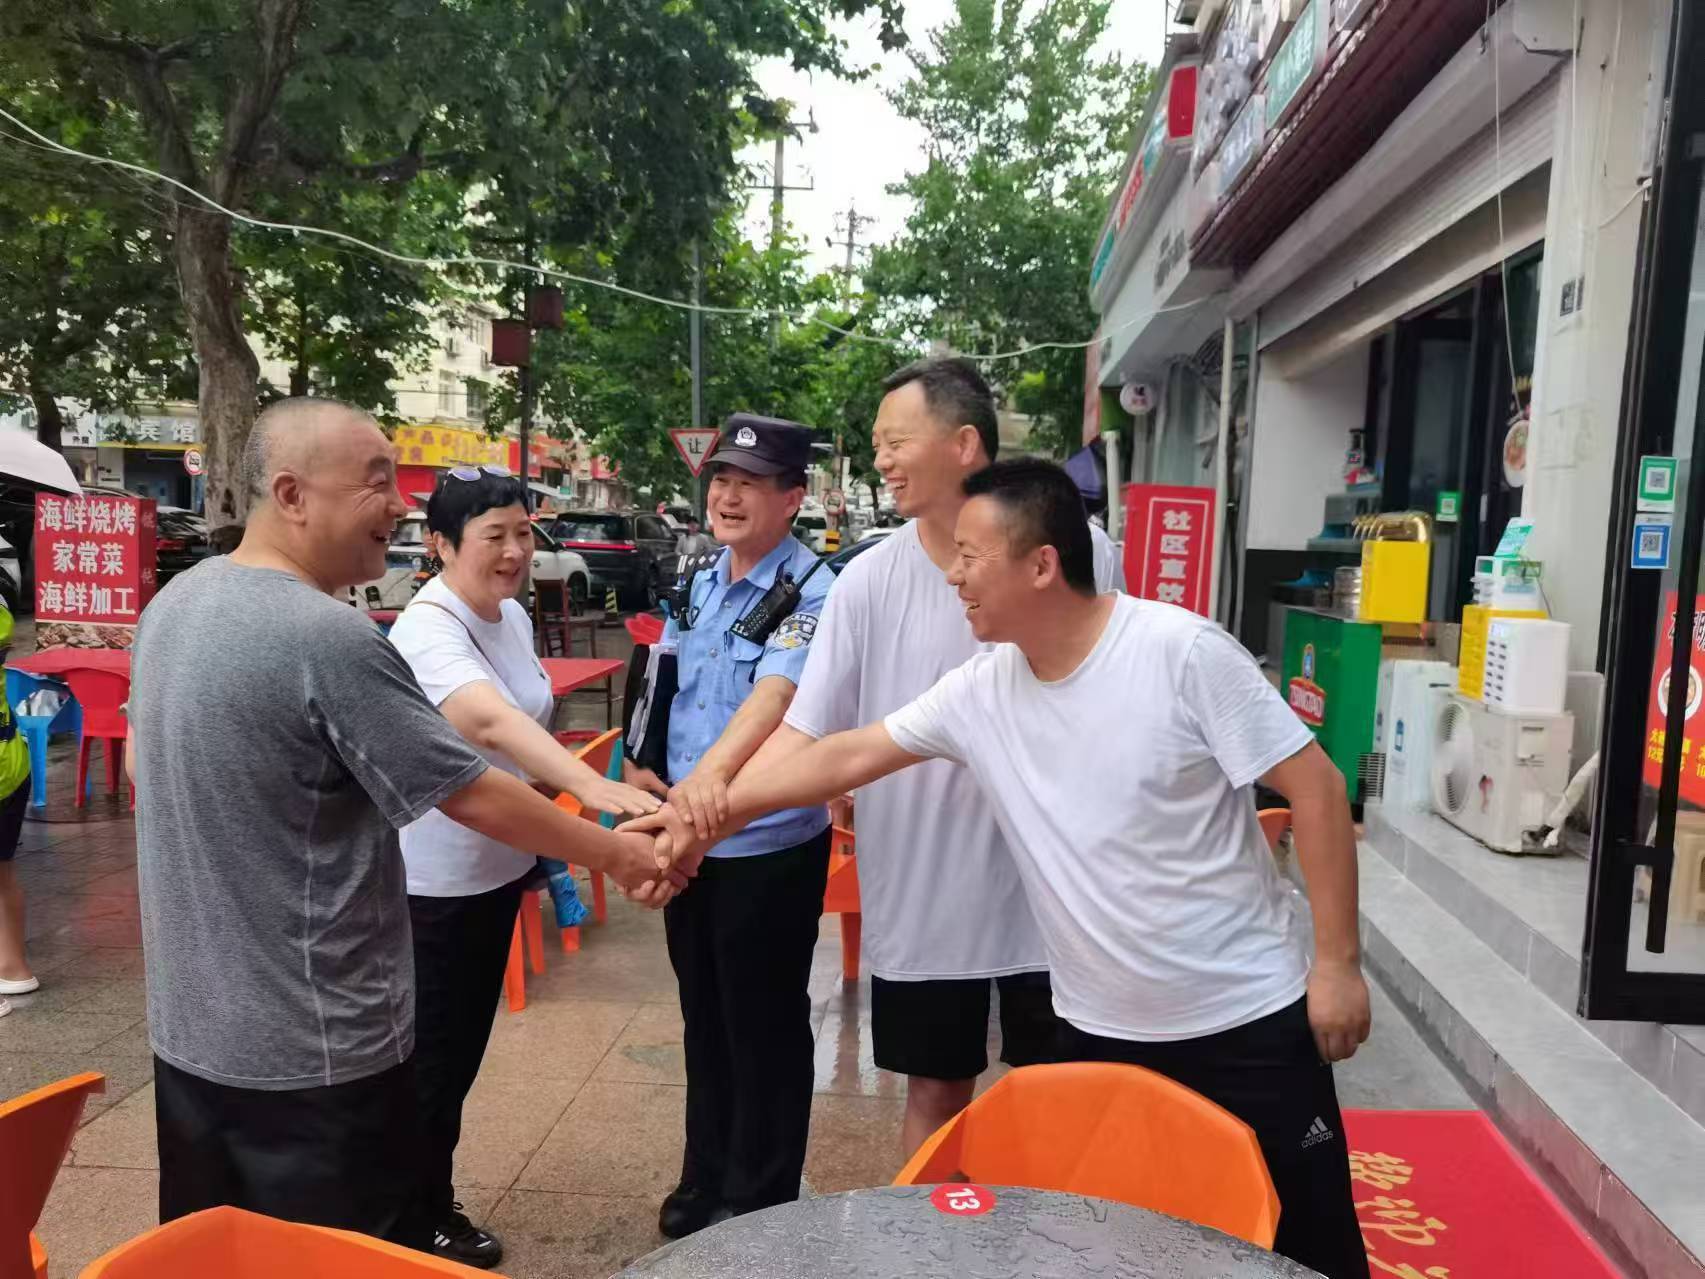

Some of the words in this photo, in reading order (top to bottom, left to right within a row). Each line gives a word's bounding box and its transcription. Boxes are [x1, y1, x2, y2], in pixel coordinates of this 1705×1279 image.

[687, 437, 703, 454] 让
[39, 498, 137, 536] 海鲜烧烤
[52, 539, 125, 577] 家常菜
[39, 580, 136, 615] 海鲜加工
[1301, 1130, 1334, 1148] adidas
[945, 1187, 981, 1210] 13
